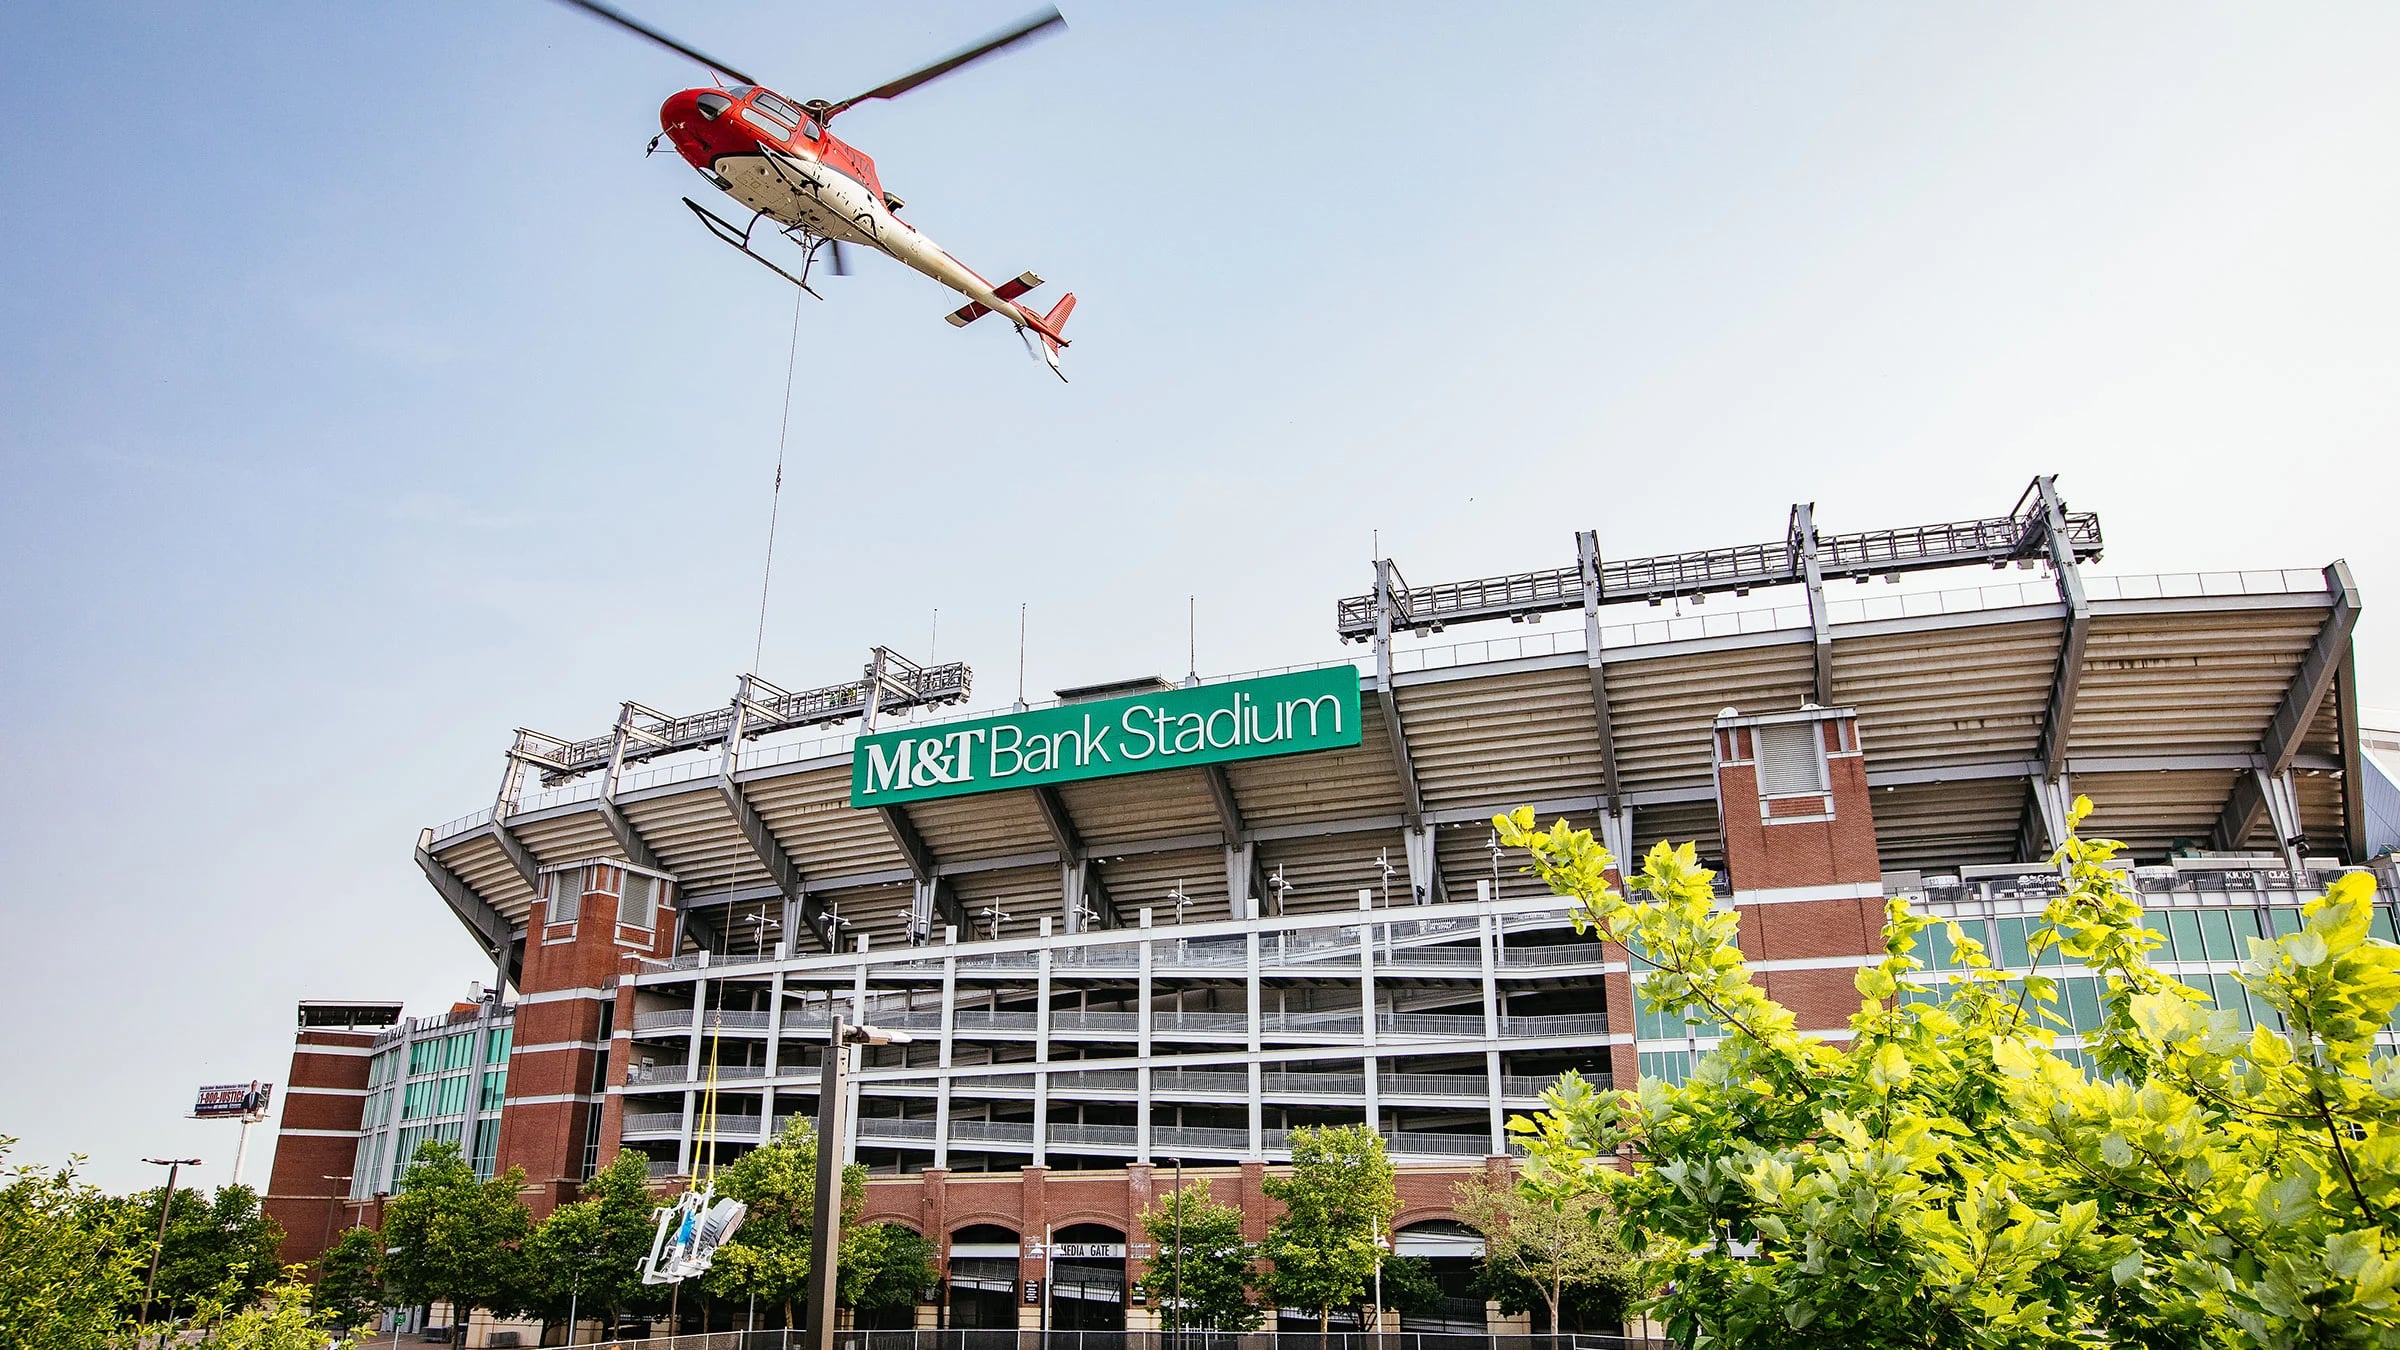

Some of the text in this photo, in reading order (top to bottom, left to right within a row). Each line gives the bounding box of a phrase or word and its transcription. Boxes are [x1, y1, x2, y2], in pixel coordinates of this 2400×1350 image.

[862, 692, 1343, 795] M&T Bank Stadium
[1090, 1244, 1110, 1257] GATE
